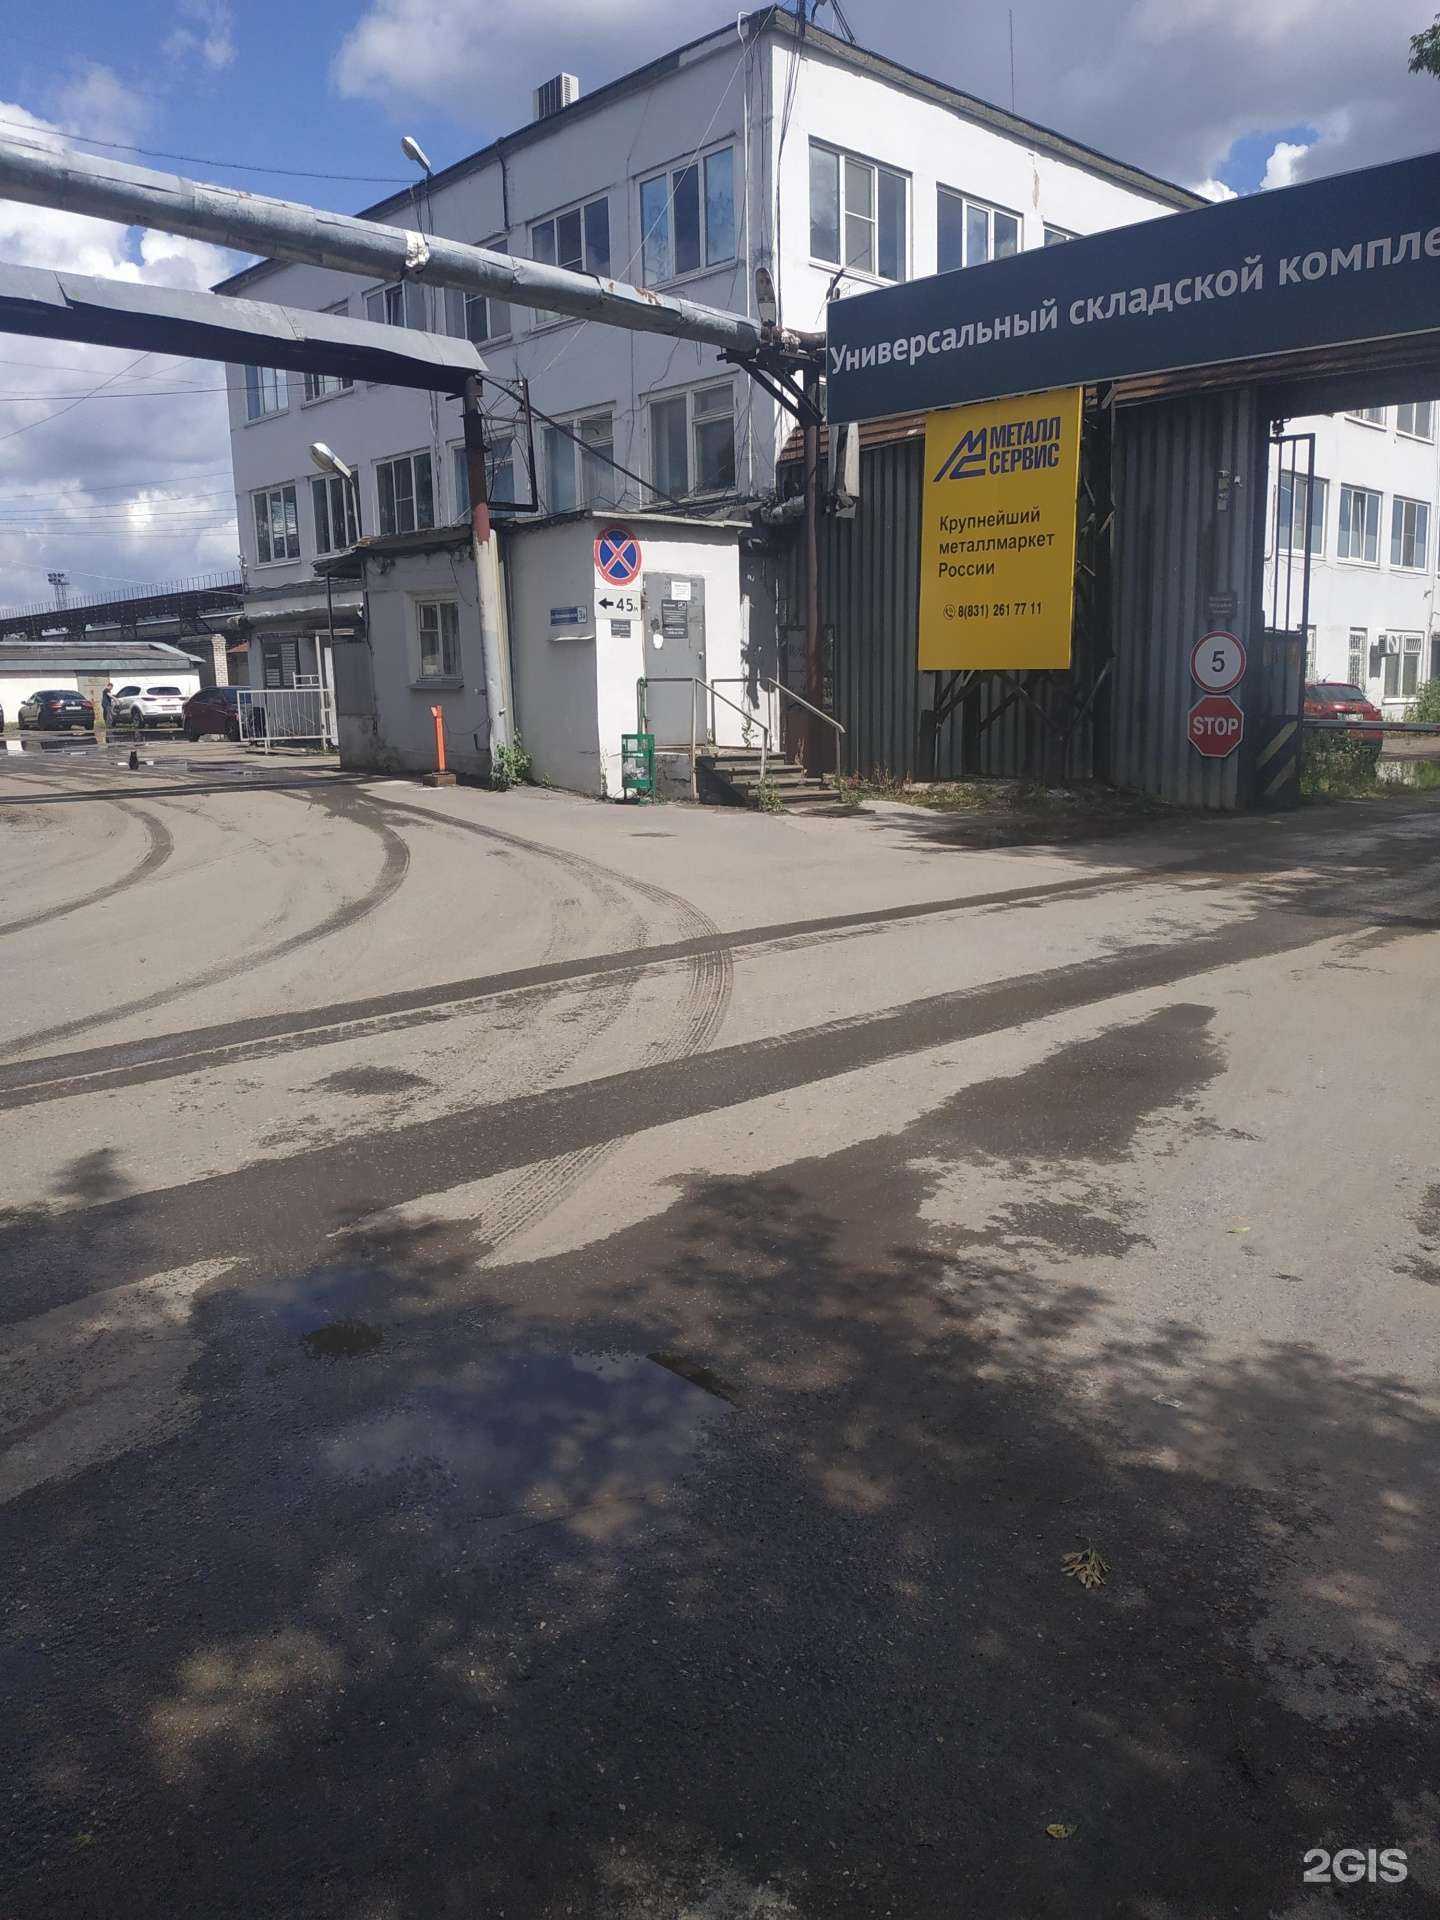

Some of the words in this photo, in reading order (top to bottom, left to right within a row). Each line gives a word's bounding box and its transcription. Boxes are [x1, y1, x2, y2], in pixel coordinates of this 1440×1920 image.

[829, 298, 1058, 375] Универсальный
[1070, 255, 1264, 326] складской
[1279, 226, 1440, 286] компле
[990, 416, 1061, 449] МЕТАЛЛ
[989, 443, 1060, 475] СЕРВИС
[939, 505, 1040, 534] Крупнейший
[939, 533, 1055, 555] металлмаркет
[938, 562, 995, 578] России
[958, 604, 989, 620] 8(831)
[993, 603, 1010, 617] 261
[1014, 602, 1027, 616] 77
[1030, 601, 1042, 615] 11
[1211, 650, 1226, 673] 5
[1192, 716, 1239, 736] STOP
